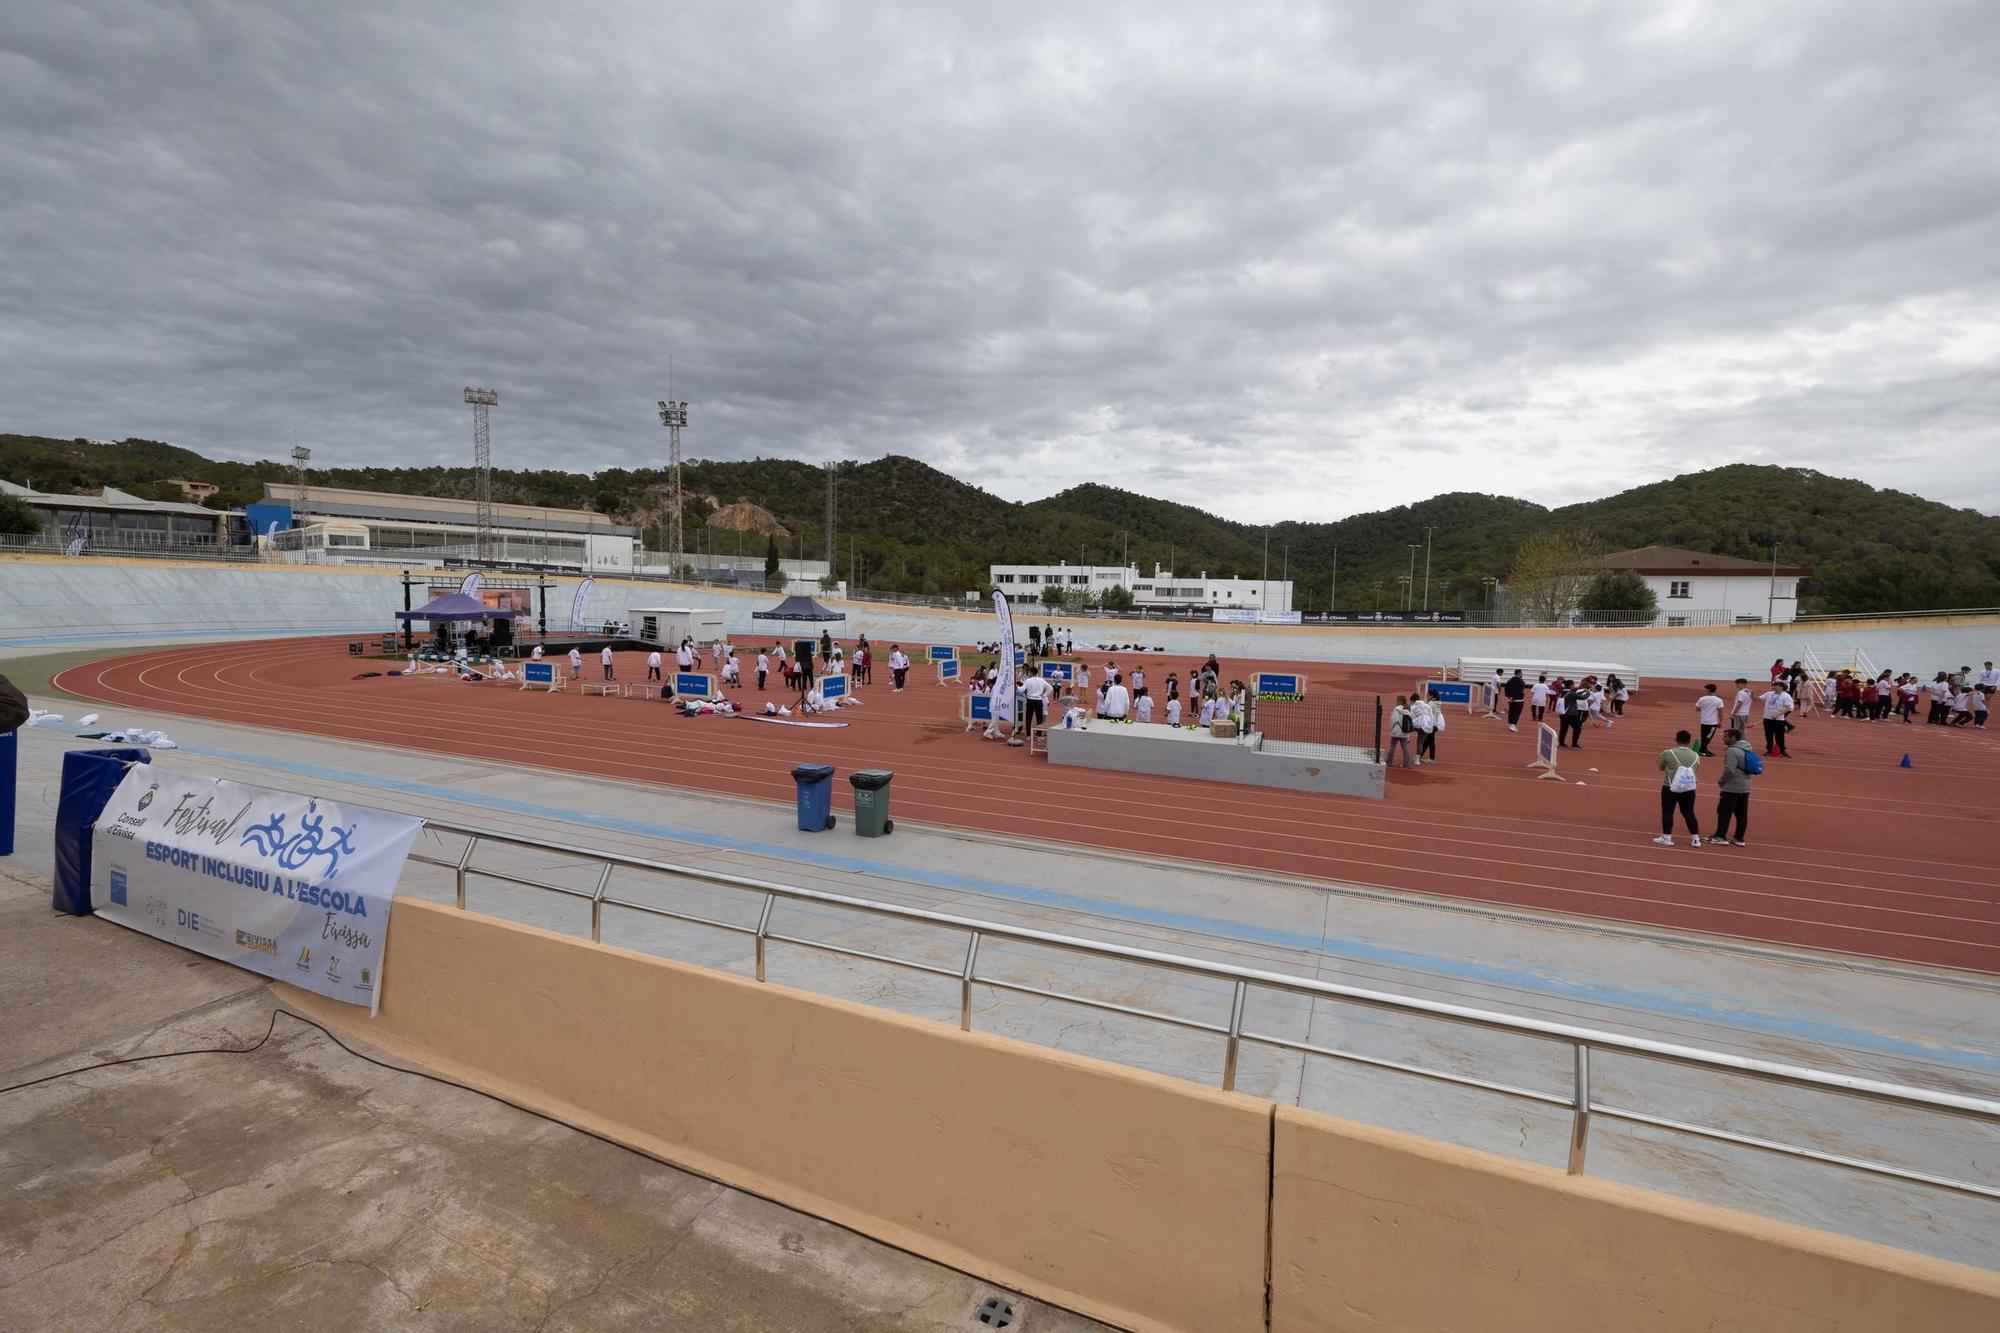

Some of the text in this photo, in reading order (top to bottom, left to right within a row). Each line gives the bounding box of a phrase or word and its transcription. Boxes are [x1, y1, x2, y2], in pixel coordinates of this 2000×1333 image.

[117, 812, 148, 828] Consell
[163, 792, 252, 845] Festival
[146, 841, 367, 917] ESPORT INCLUSIU A L'ESCOLA
[178, 908, 199, 931] DIE
[322, 911, 373, 949] Eivissa
